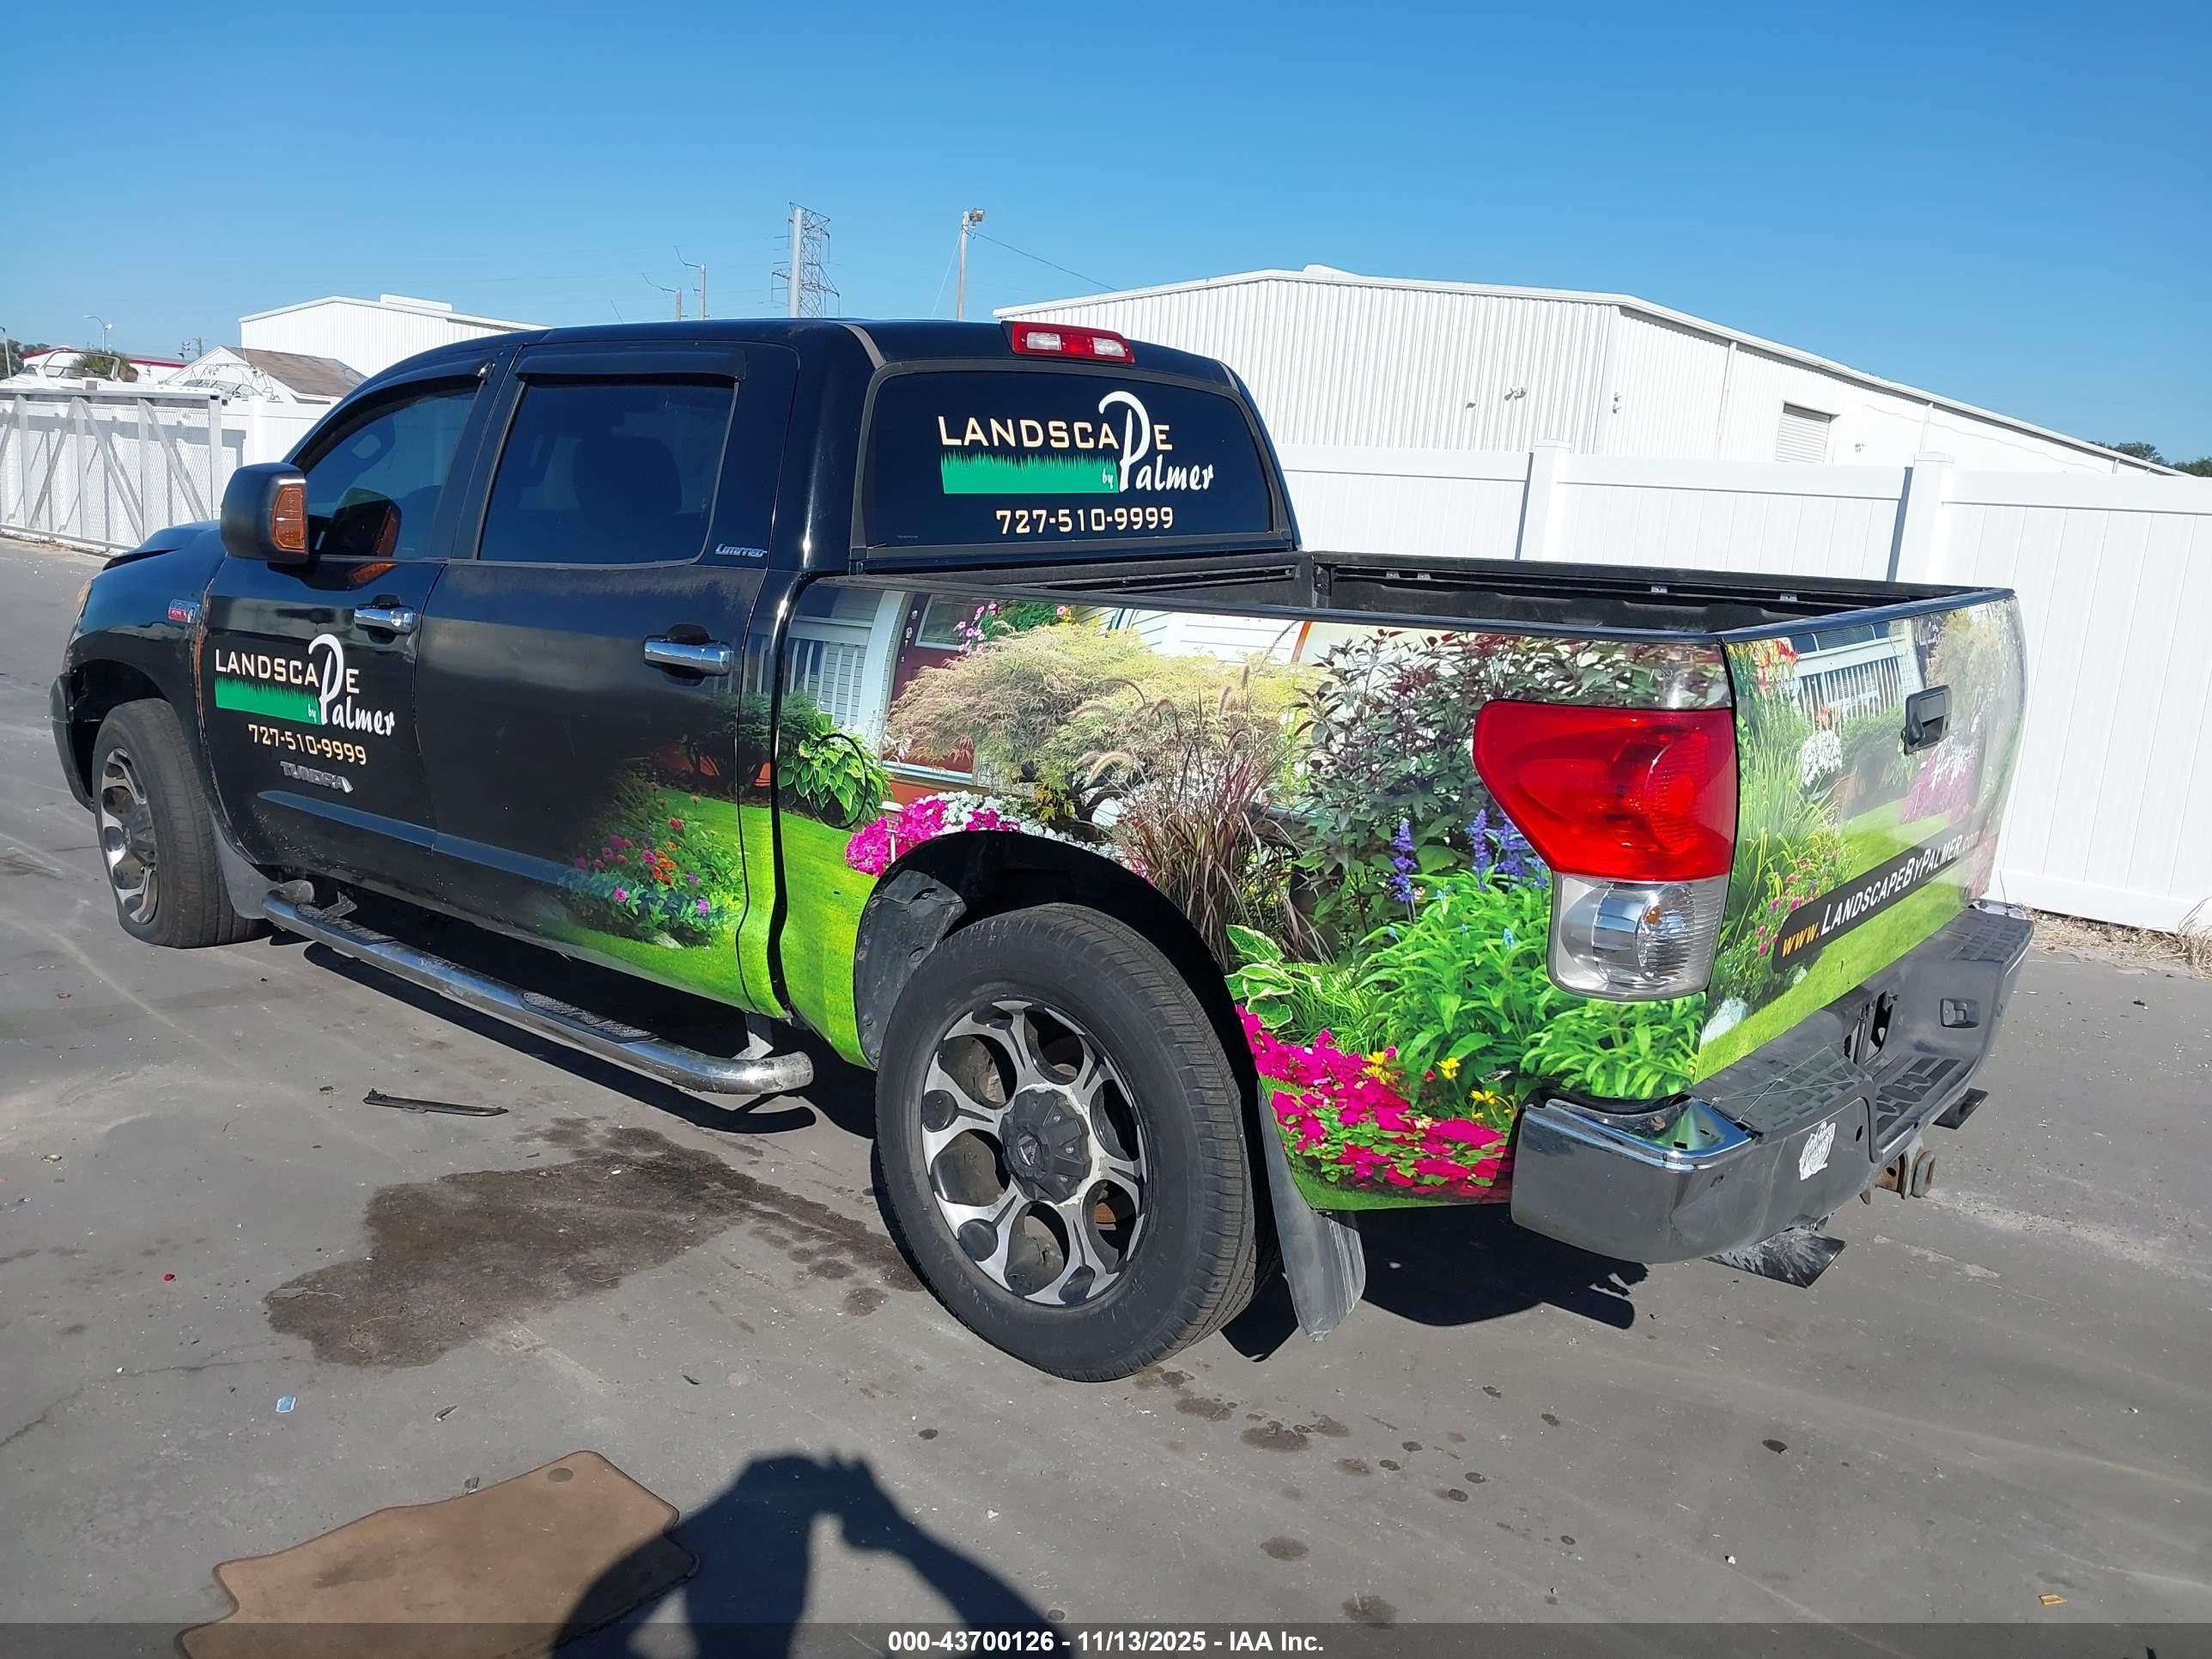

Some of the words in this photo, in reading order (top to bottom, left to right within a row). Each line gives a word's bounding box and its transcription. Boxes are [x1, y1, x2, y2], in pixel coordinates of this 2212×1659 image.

[938, 391, 1174, 453] LANDSCAPE
[1102, 468, 1114, 489] by
[996, 507, 1174, 535] 727-510-9999
[216, 634, 360, 697] LANDSCAPE
[307, 704, 317, 723] by
[248, 724, 367, 765] 727-510-9999
